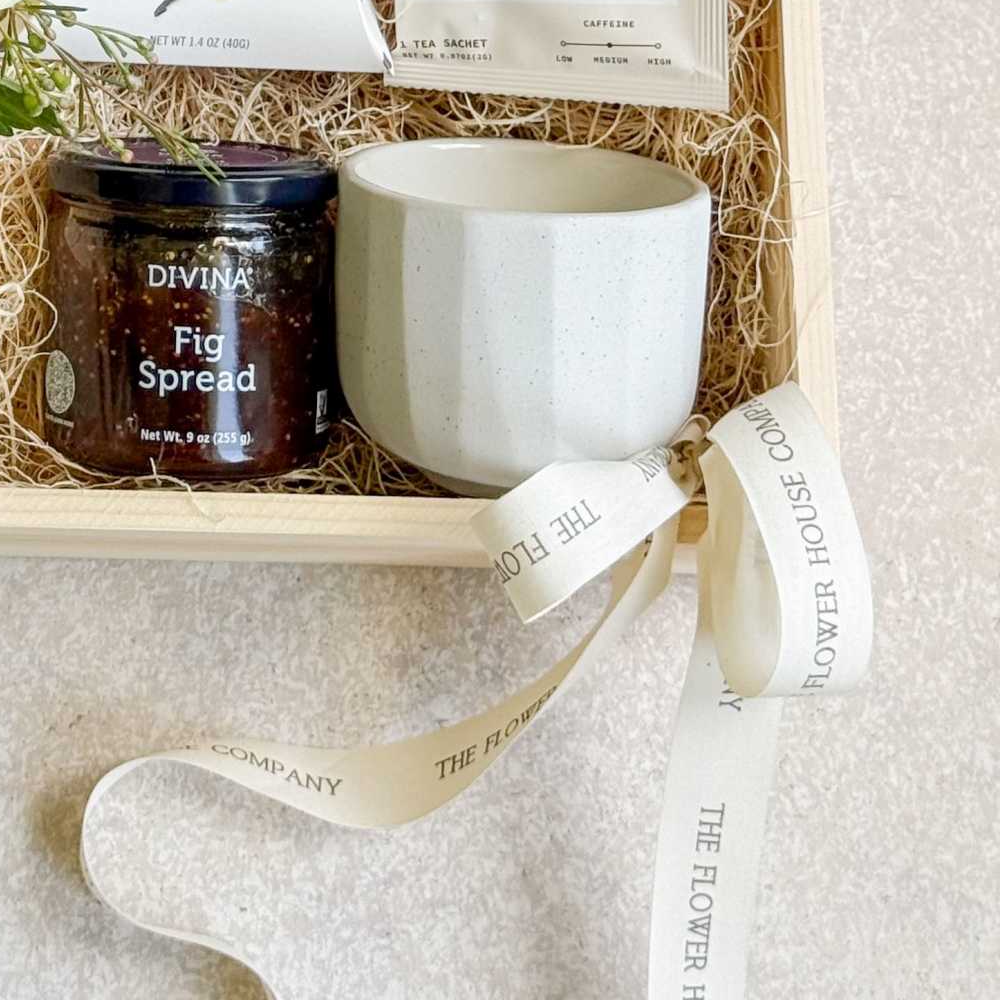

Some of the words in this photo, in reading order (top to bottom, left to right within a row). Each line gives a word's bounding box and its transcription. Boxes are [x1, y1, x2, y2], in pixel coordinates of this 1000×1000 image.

[171, 35, 186, 47] WT
[206, 37, 220, 48] OZ
[222, 37, 250, 49] (40G)
[583, 20, 635, 28] CAFFEINE
[413, 40, 436, 49] TEA
[443, 39, 488, 48] SACHET
[556, 55, 573, 63] LOW
[593, 56, 629, 64] MEDIUM
[148, 264, 250, 290] DIVINA
[174, 326, 225, 362] Fig
[139, 361, 256, 397] Spread
[140, 428, 161, 442] Net
[163, 429, 183, 442] Wt.
[186, 431, 194, 442] 9
[196, 434, 210, 443] oz
[213, 430, 237, 444] (255
[549, 499, 602, 545] THE
[780, 471, 831, 567] HOUSE
[801, 579, 839, 689] FLOWER
[211, 744, 344, 796] COMPANY
[434, 744, 477, 780] THE
[695, 803, 726, 853] THE
[683, 863, 718, 973] FLOWER
